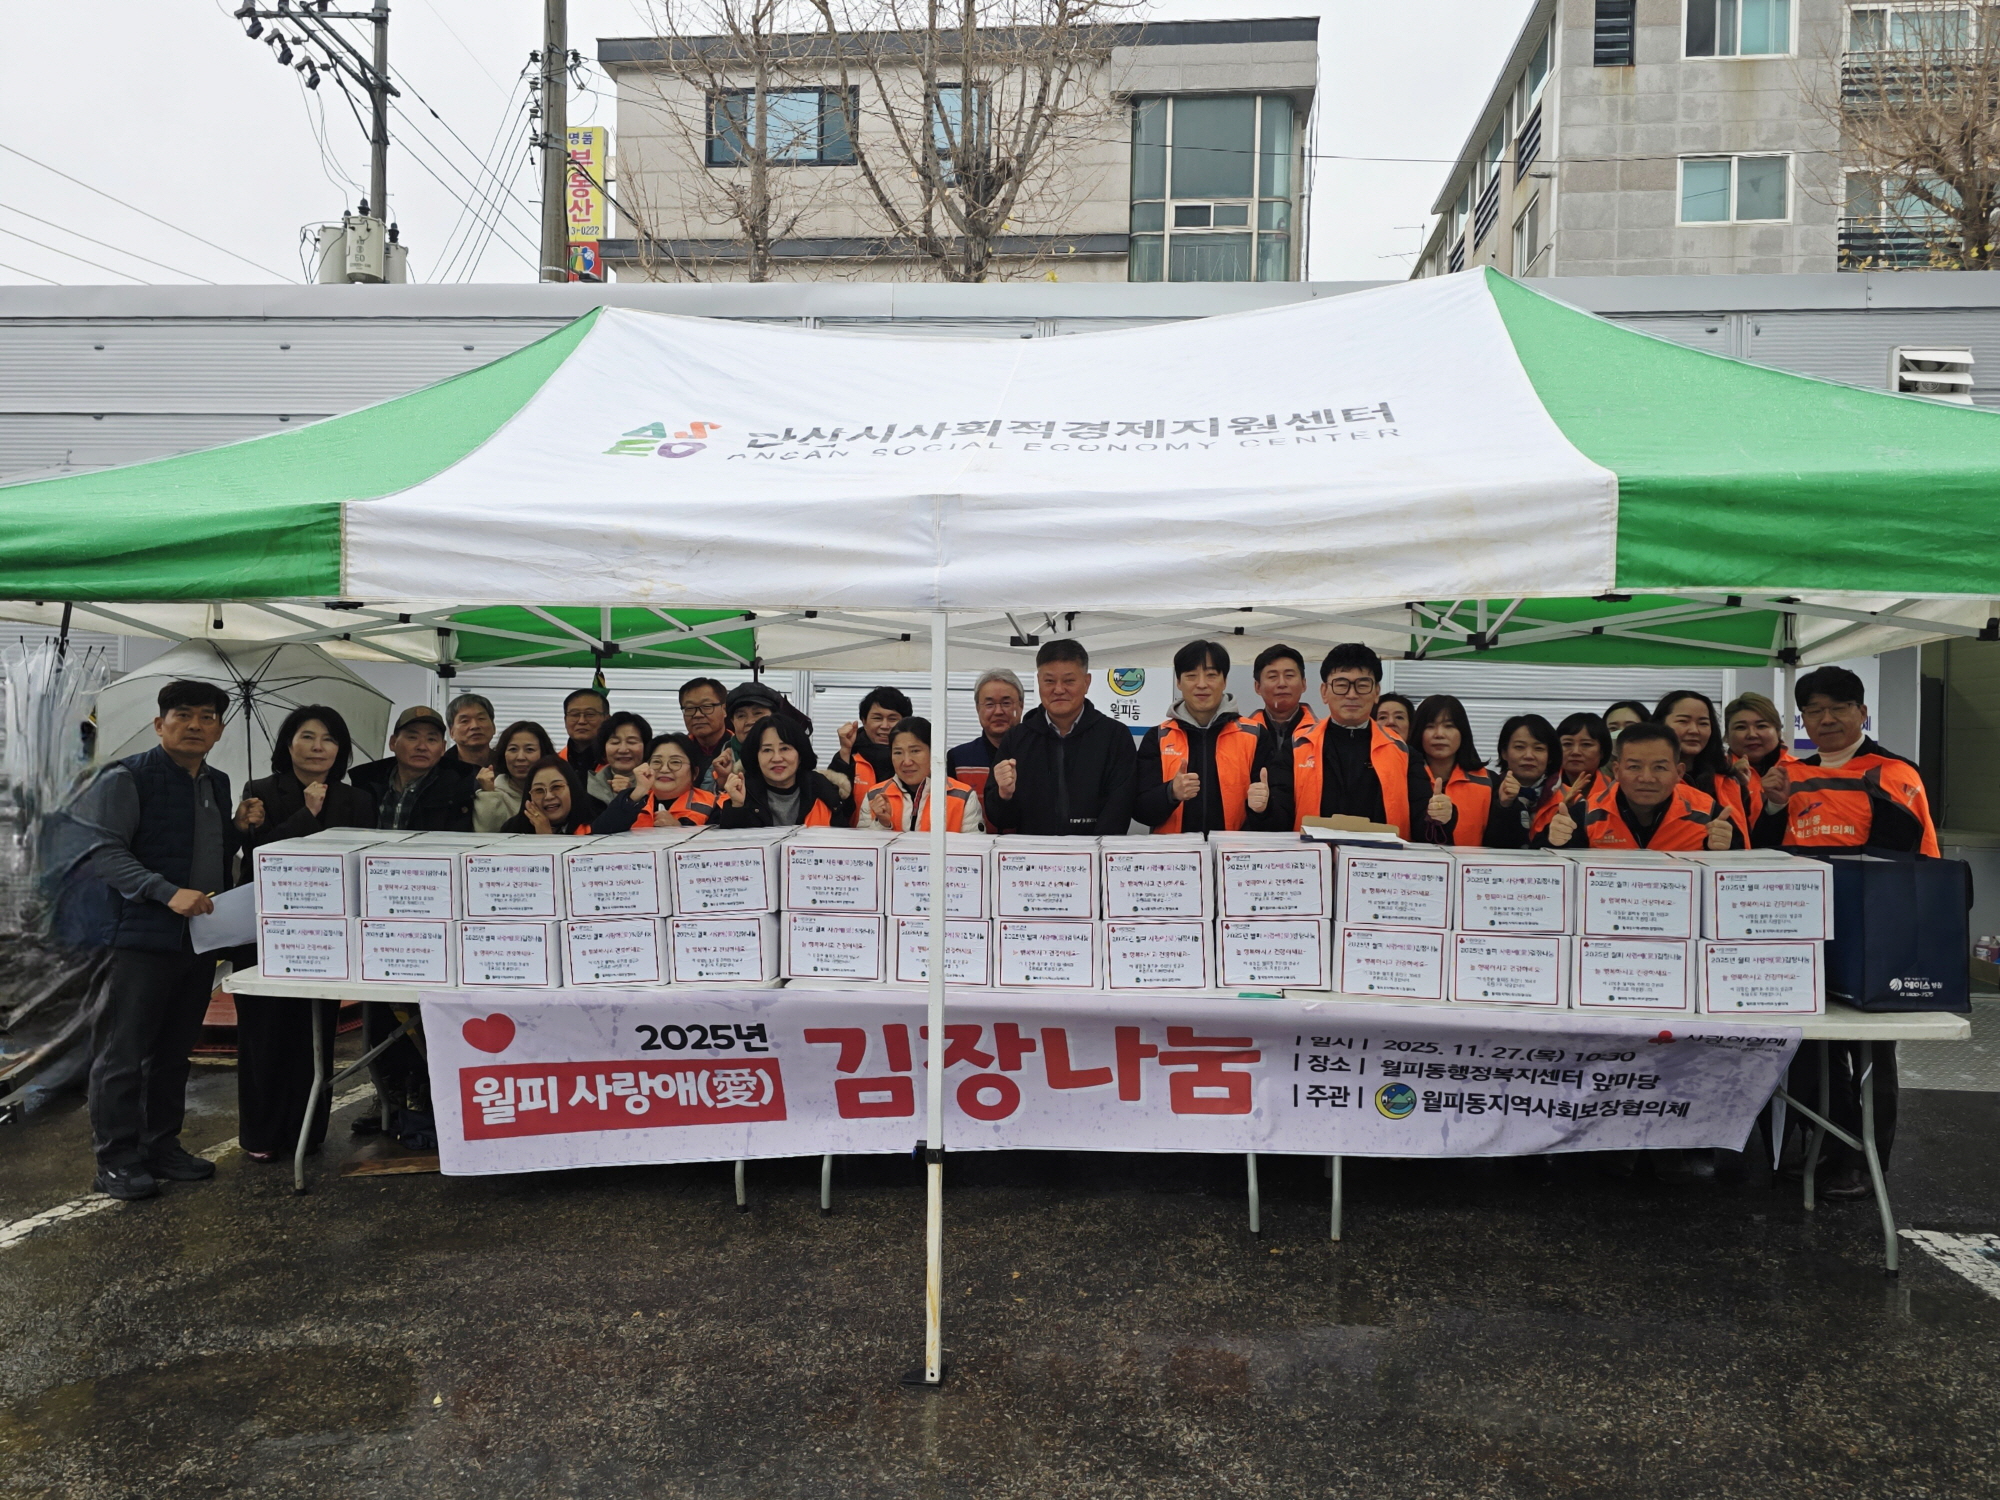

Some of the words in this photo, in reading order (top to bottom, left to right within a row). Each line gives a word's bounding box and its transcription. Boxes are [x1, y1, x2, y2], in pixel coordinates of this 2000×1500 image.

[872, 441, 1003, 457] SOCIAL
[1023, 440, 1218, 452] ECONOMY
[1239, 427, 1402, 448] CENTER
[1110, 703, 1141, 721] 월피동
[635, 1023, 769, 1052] 2025년
[1310, 1036, 1353, 1050] 일시
[1383, 1040, 1443, 1055] 2025.
[1453, 1044, 1484, 1058] 11.
[803, 1023, 1262, 1121] 김장나눔
[1307, 1054, 1351, 1073] 장소
[1380, 1059, 1584, 1089] 월피동행정복지센터
[1592, 1072, 1661, 1091] 앞마당
[472, 1074, 559, 1126] 월피
[568, 1068, 774, 1116] 사랑애(愛)
[1306, 1084, 1350, 1108] 주관
[1421, 1090, 1691, 1121] 월피동지역사회보장협의체
